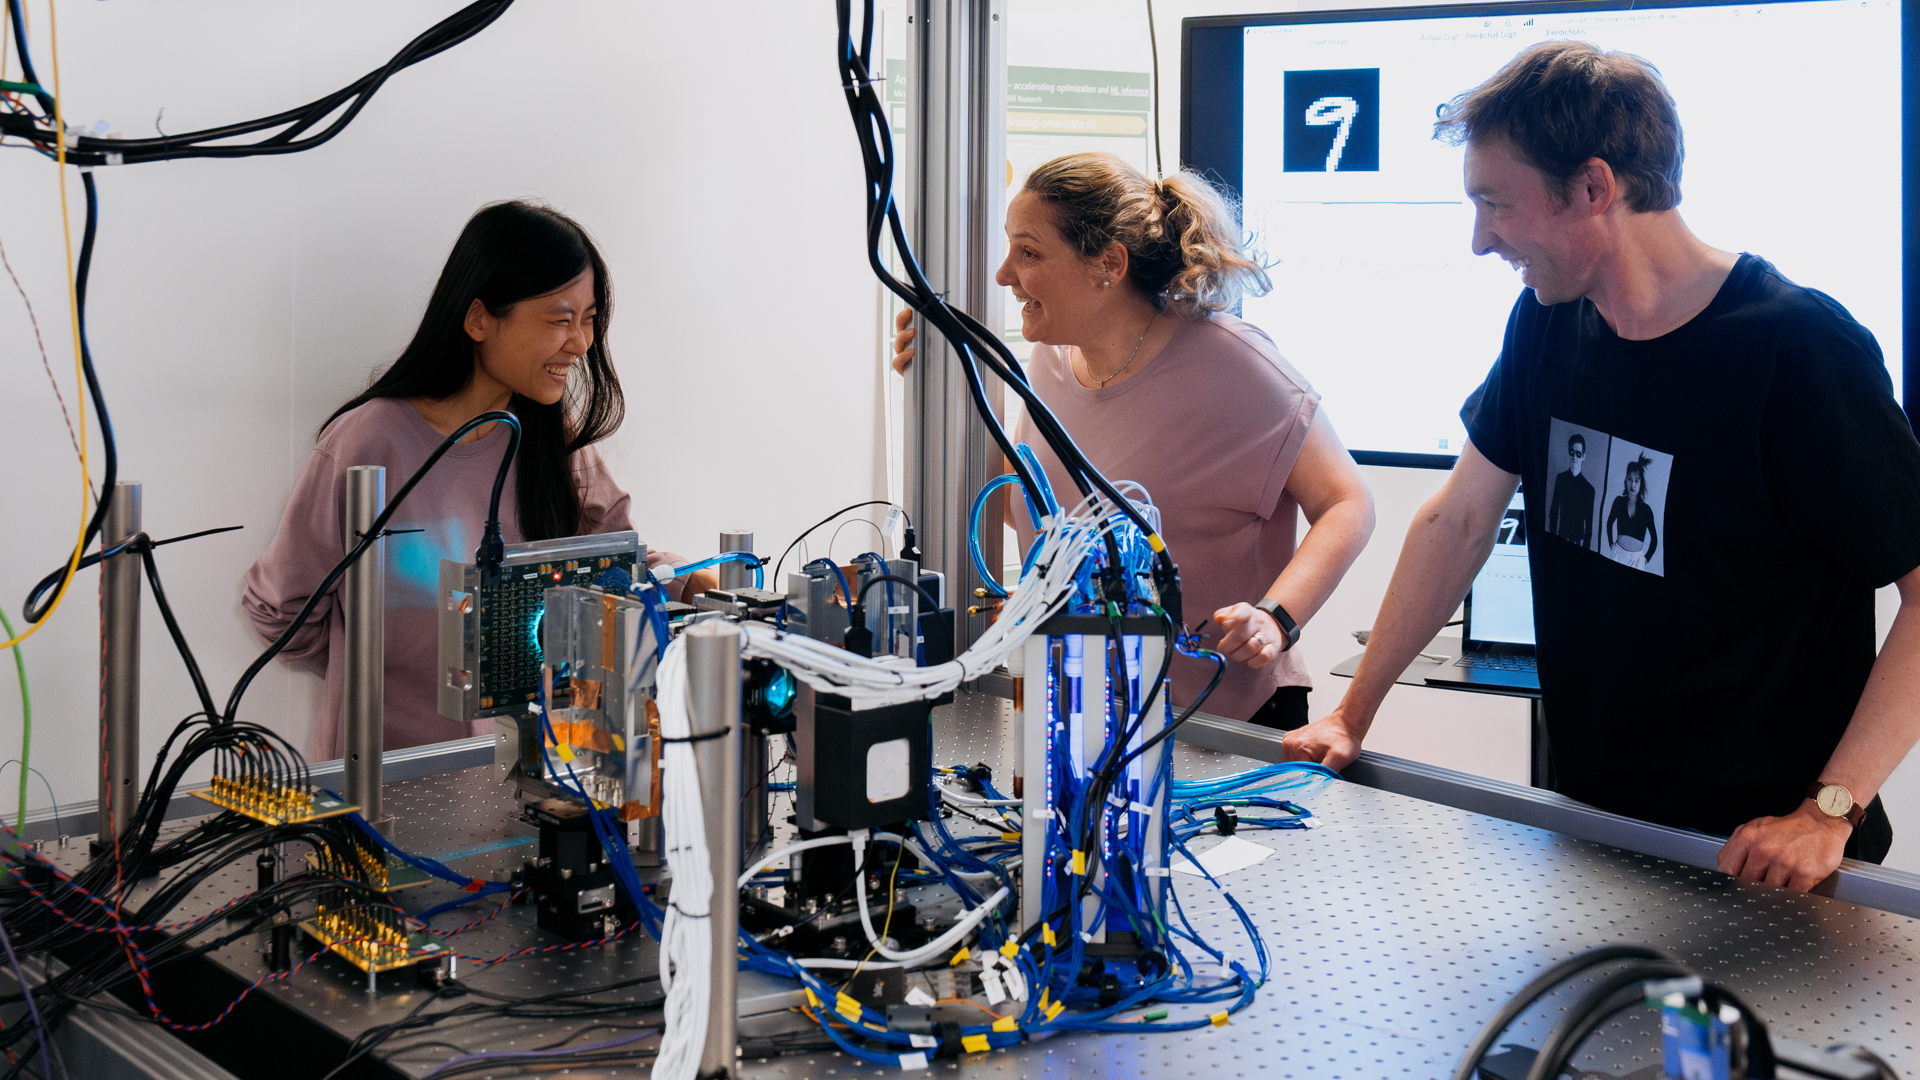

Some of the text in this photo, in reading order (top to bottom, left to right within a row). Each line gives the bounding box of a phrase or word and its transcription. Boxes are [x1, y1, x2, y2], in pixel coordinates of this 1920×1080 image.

[1546, 28, 1586, 36] Predictions
[1013, 82, 1055, 93] accelerating
[1056, 84, 1097, 94] optimization
[1097, 86, 1109, 94] and
[1110, 86, 1120, 95] ML
[1121, 87, 1149, 96] inference
[1017, 95, 1042, 103] Research
[1007, 117, 1097, 130] Analog-amenable ML
